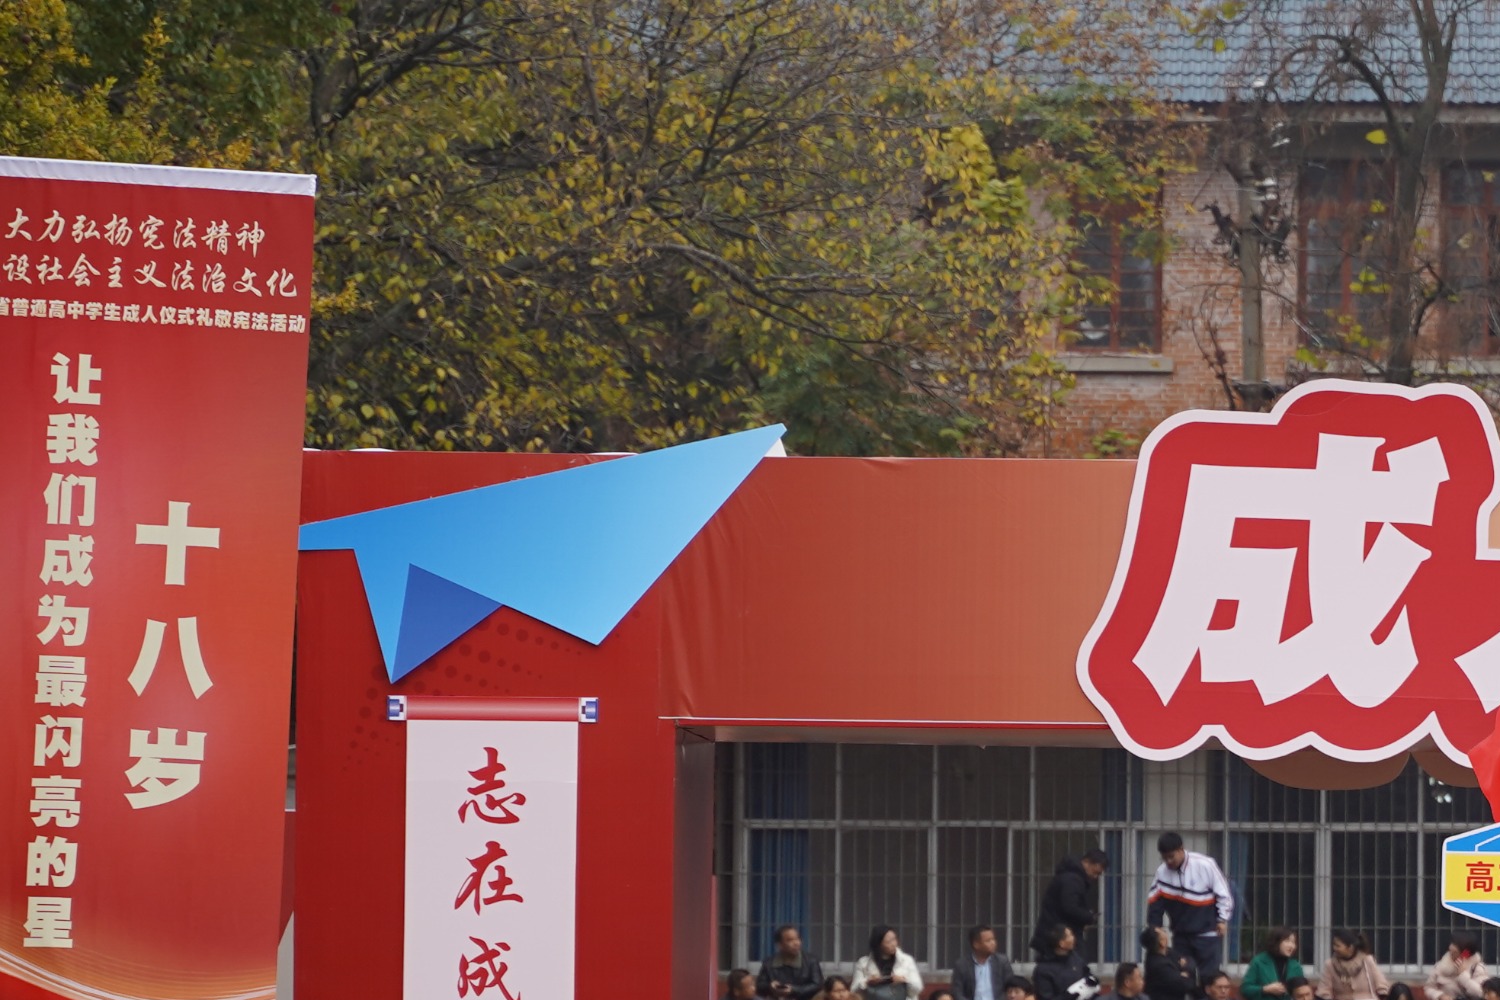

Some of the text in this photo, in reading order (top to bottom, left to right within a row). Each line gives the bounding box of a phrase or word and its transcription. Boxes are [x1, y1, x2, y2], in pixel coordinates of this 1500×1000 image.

[2, 252, 298, 298] 设社会主义法治文化
[4, 207, 266, 257] 大力弘扬宪法精神
[22, 351, 102, 949] 让我们成为最闪亮的星
[124, 500, 220, 810] 十八岁
